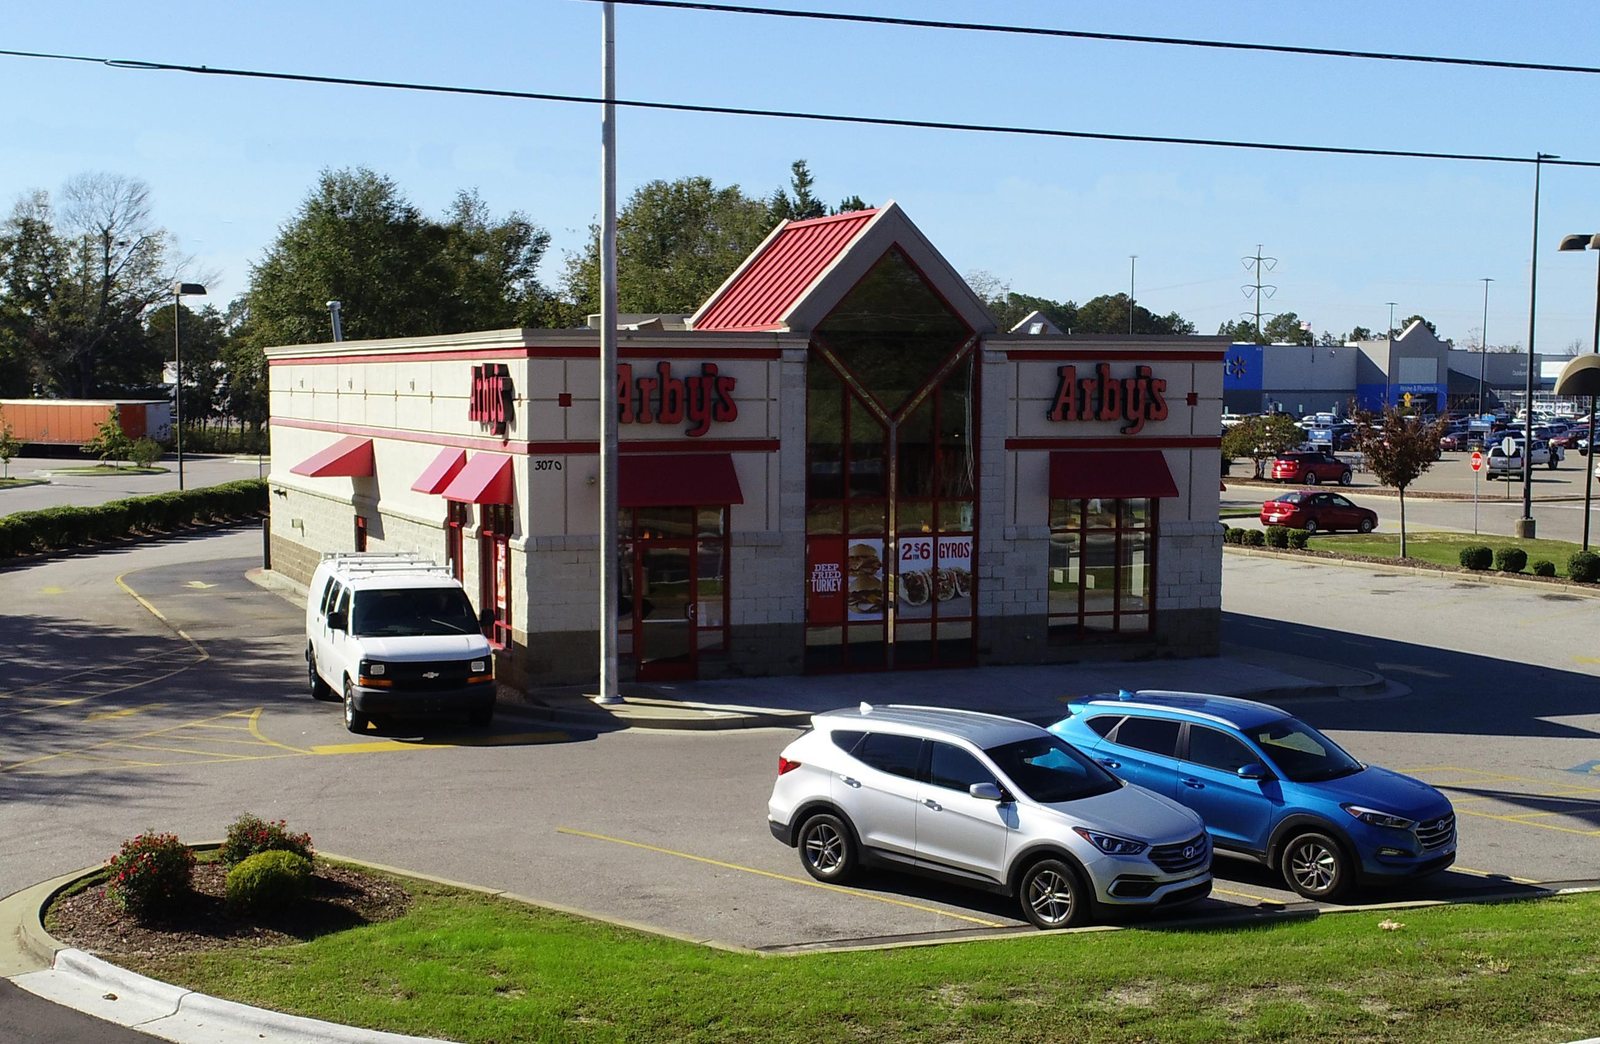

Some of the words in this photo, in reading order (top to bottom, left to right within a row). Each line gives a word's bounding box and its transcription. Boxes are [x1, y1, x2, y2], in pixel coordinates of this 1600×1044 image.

[616, 361, 738, 437] Arby's
[1047, 363, 1168, 435] Arby's
[534, 460, 562, 471] 3070
[939, 541, 970, 559] GYROS
[811, 571, 841, 579] FRIED
[814, 563, 839, 572] DEEP
[810, 578, 842, 593] TURKEY
